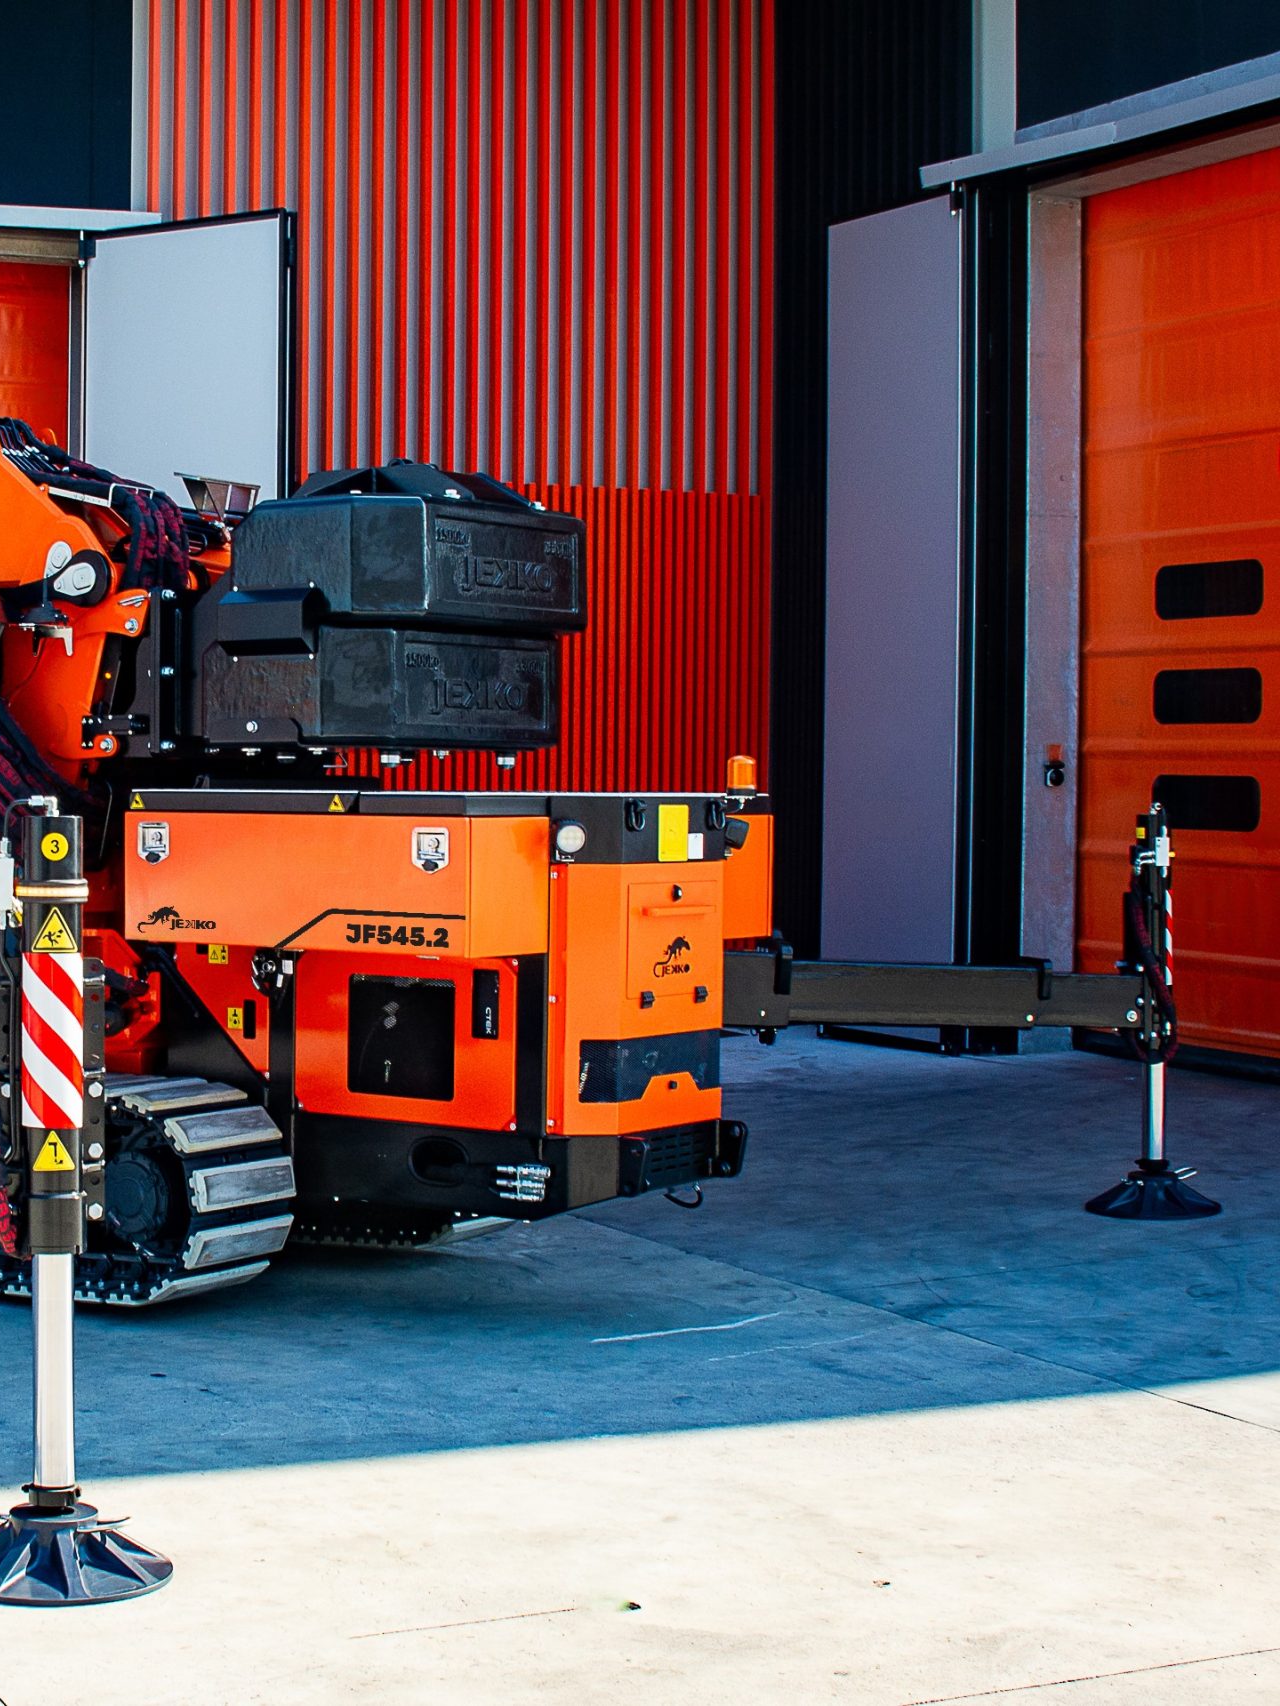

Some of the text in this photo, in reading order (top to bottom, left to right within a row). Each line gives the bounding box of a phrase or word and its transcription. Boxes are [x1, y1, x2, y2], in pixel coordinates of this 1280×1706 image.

[458, 554, 553, 592] JEKKO
[428, 677, 524, 715] JEKKO
[50, 839, 60, 854] 3
[169, 918, 217, 930] JEKKO
[345, 923, 450, 948] JF545.2
[660, 963, 690, 977] JEKKO
